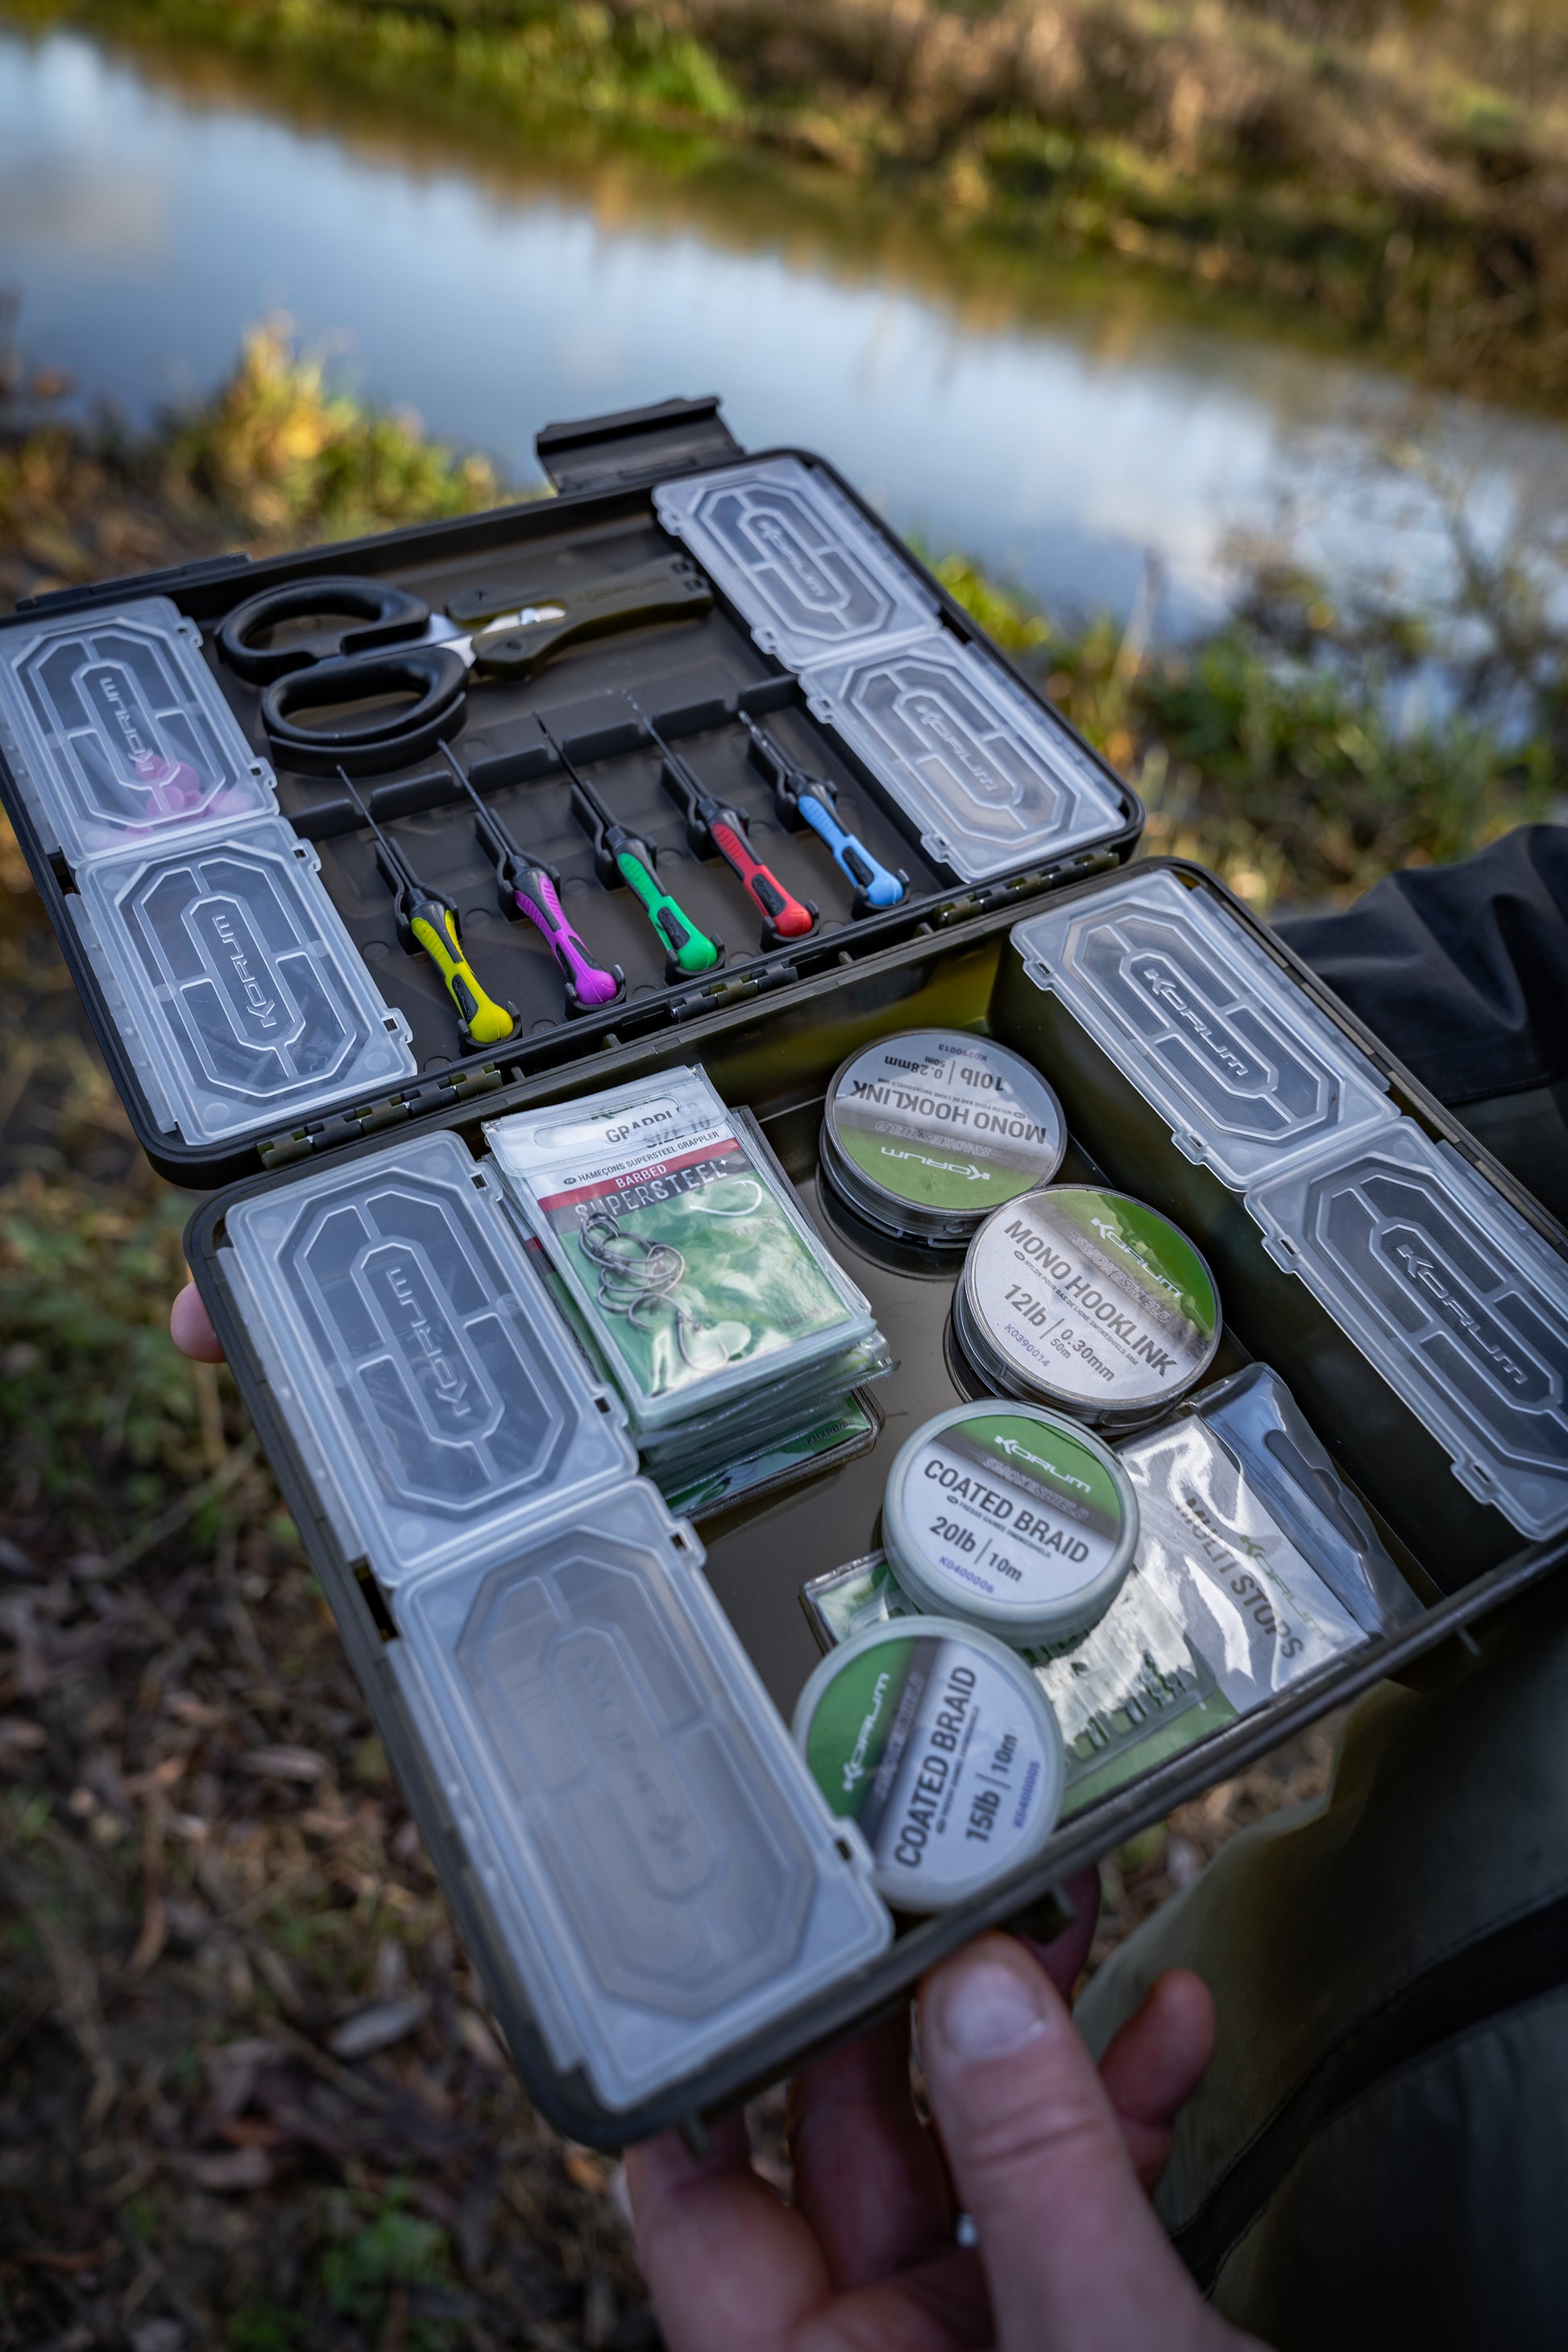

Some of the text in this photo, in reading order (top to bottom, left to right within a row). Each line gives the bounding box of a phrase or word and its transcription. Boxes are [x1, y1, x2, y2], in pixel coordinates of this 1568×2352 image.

[1143, 968, 1249, 1076] KORUM
[883, 1054, 1006, 1093] 10lb 0.28mm
[849, 1078, 1047, 1146] MONO HOOKLINK
[874, 1118, 992, 1160] SMOKESHIELD
[578, 1163, 625, 1182] HAMEÇONS
[625, 1144, 678, 1168] SUPERSTEEL
[677, 1130, 720, 1151] GRAPPLER
[616, 1164, 668, 1188] BARBED
[880, 1146, 991, 1182] KORUM
[575, 1160, 728, 1226] SUPERSTEEL
[1071, 1232, 1173, 1326] SMOKESHIELD
[1090, 1217, 1182, 1300] KORUM
[1002, 1281, 1118, 1382] 12lb 0.30mm
[1003, 1217, 1178, 1379] MONO HOOKLINK
[1396, 1242, 1529, 1385] KORUM
[1003, 1323, 1052, 1368] K0390014
[1049, 1337, 1073, 1360] 50m
[993, 1433, 1091, 1495] KORUM
[923, 1457, 1092, 1566] COATED BRAID
[928, 1513, 1025, 1583] 20lb 10m
[938, 1555, 997, 1595] K0400006
[1228, 1570, 1307, 1662] STOPS
[842, 1671, 890, 1793] KORUM
[892, 1753, 950, 1869] COATED
[930, 1665, 978, 1753] BRAID
[963, 1732, 1018, 1844] 15lb 10m
